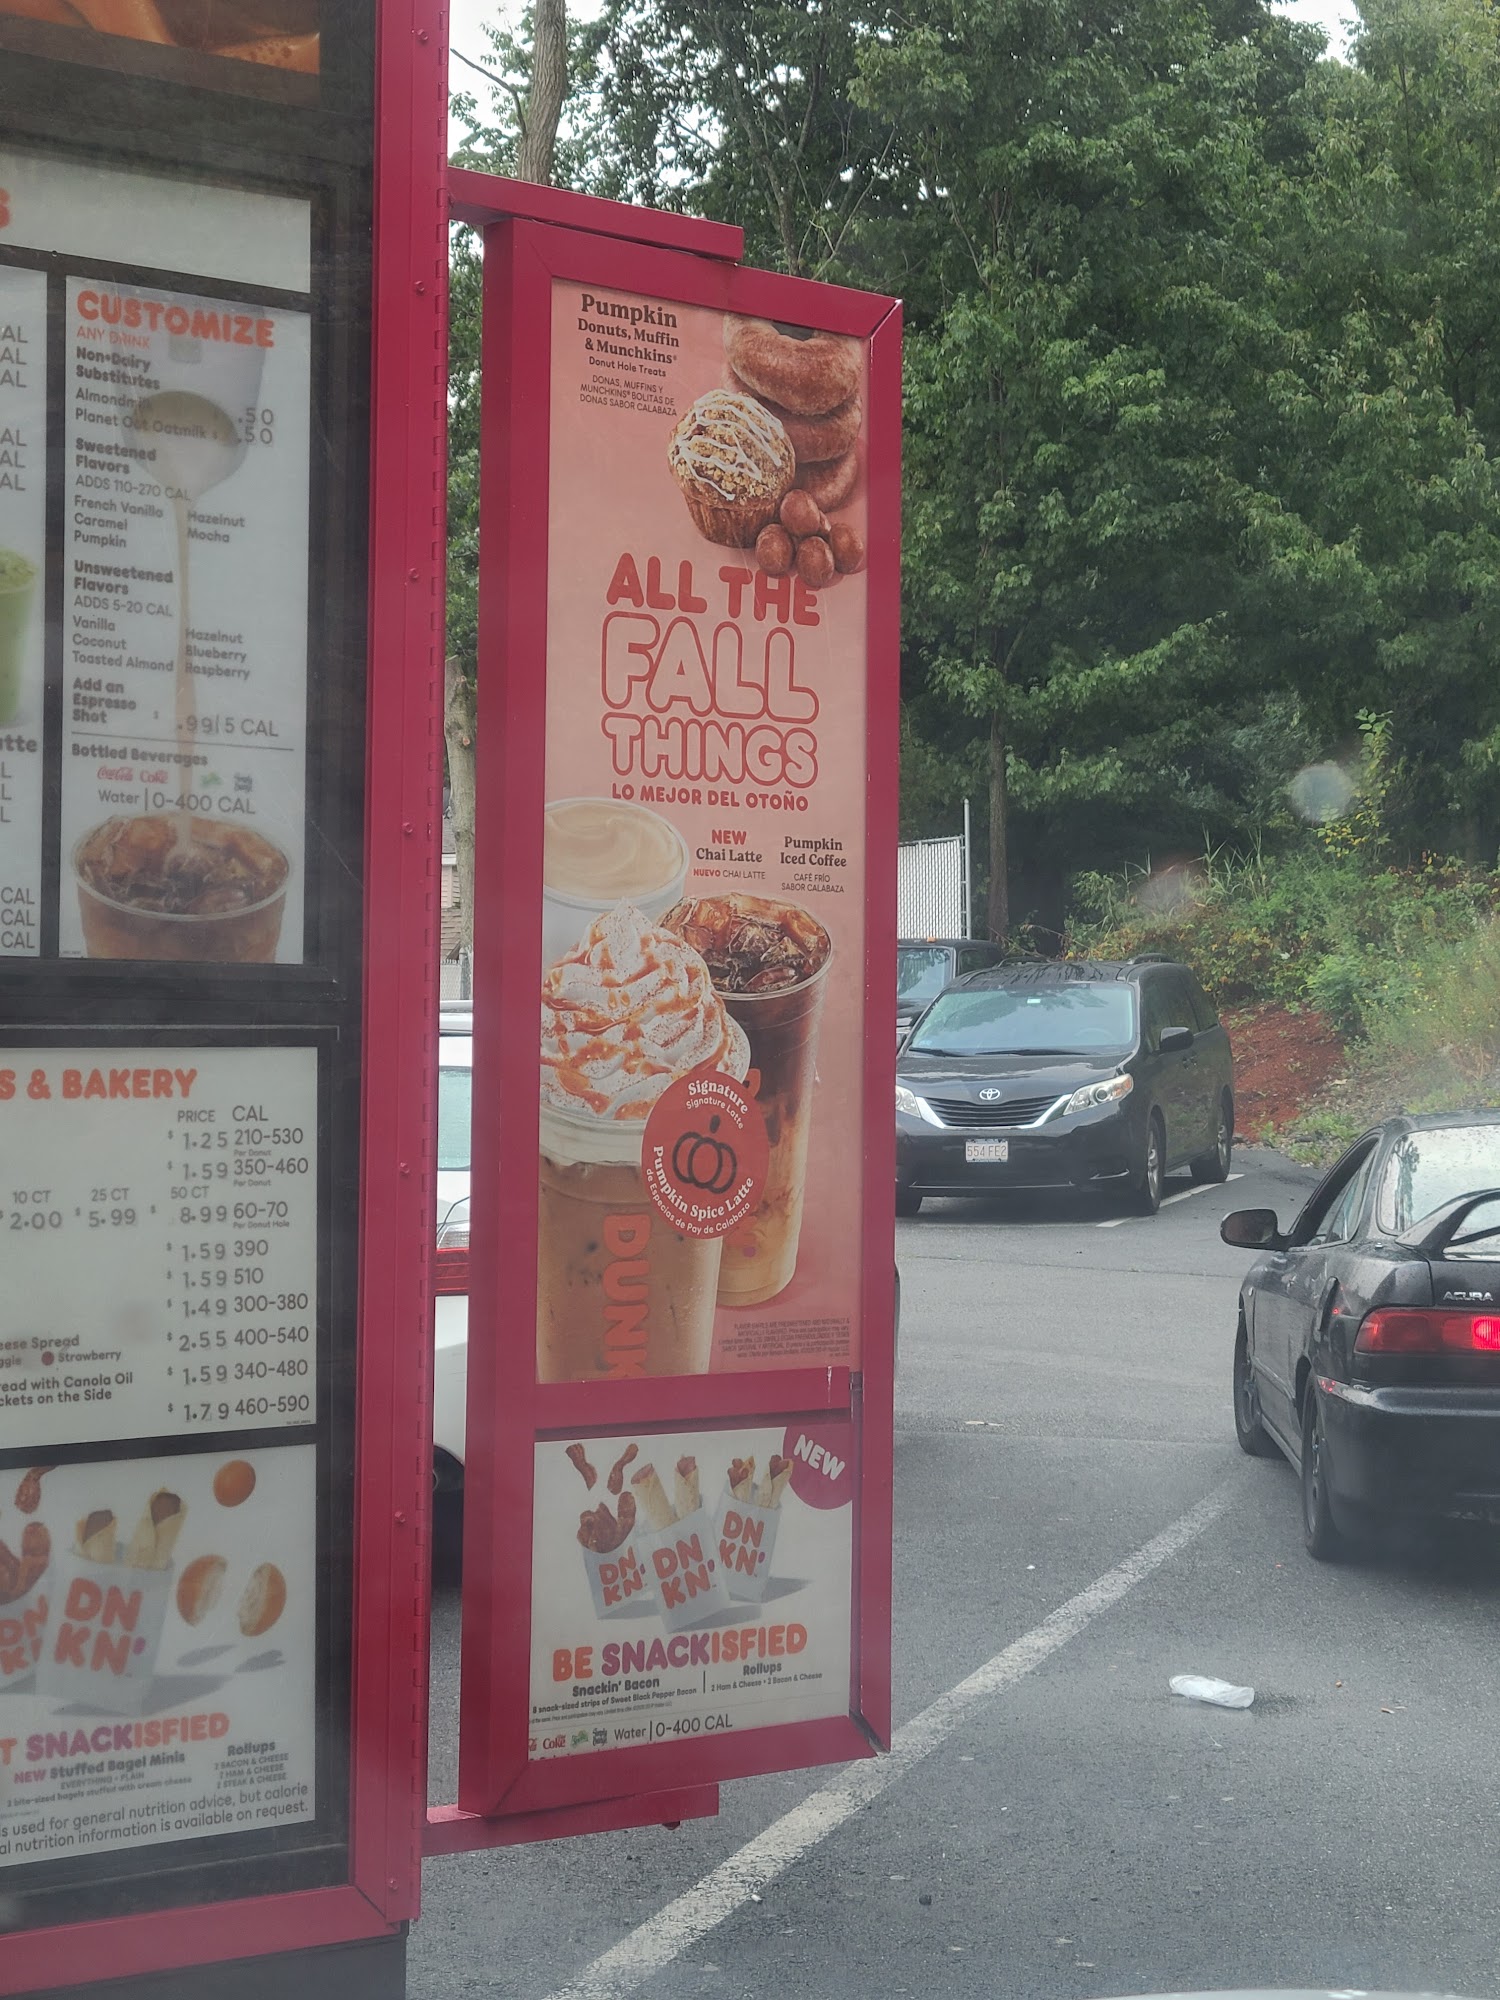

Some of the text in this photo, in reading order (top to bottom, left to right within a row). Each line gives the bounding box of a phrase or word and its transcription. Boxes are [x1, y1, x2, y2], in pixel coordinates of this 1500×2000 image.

[77, 290, 275, 348] CUSTOMIZE
[581, 294, 678, 328] Pumpkin
[77, 326, 150, 349] ANY DRINK
[578, 318, 679, 347] Donuts, Muffin
[585, 338, 594, 351] &
[589, 356, 666, 377] Donut Hole Treats
[76, 365, 160, 390] Substitutes
[76, 437, 157, 462] Sweetened
[76, 454, 130, 475] Flavors
[74, 495, 164, 518] French Vanilla
[74, 513, 128, 531] Caramel
[187, 510, 245, 528] Hazelnut
[74, 530, 128, 548] Pumpkin
[187, 528, 230, 544] Mocha
[74, 559, 174, 583] Unsweetened
[74, 576, 129, 595] Flavors
[606, 552, 820, 627] ALL THE
[74, 595, 173, 617] ADDS 5-20 CAL
[72, 615, 116, 631] Vanilla
[72, 633, 127, 650] Coconut
[185, 627, 244, 644] Hazelnut
[72, 650, 174, 672] Toasted Almond
[185, 644, 247, 663] Blueberry
[185, 661, 250, 682] Raspberry
[601, 610, 820, 724] FALL
[73, 676, 125, 694] Add an
[73, 692, 137, 711] Espresso
[72, 708, 107, 724] Shot
[72, 743, 208, 767] Bottled Beverages
[601, 712, 818, 788] THINGS
[98, 788, 255, 814] Water 0-400 CAL
[612, 783, 808, 811] LO MEJOR DEL OTOÑO
[712, 829, 746, 845] NEW
[784, 836, 843, 852] Pumpkin
[696, 848, 762, 863] Chai Latte
[780, 852, 847, 867] Iced Coffee
[693, 868, 765, 879] NUEVO CHAI LATTE
[794, 873, 812, 882] CAFÉ
[782, 883, 844, 893] SABOR CALABAZA
[62, 1068, 198, 1099] BAKERY
[688, 1080, 748, 1115] Signature
[177, 1105, 269, 1123] PRICE CAL
[686, 1097, 743, 1129] Signature Latte
[233, 1128, 303, 1146] 210-530
[233, 1157, 308, 1176] 350-460
[170, 1185, 210, 1200] 50 CT
[654, 1145, 754, 1222] Pumpkin Spice Latte
[13, 1190, 51, 1204] 10 CT
[91, 1188, 130, 1202] 25 CT
[233, 1200, 288, 1219] 60-70
[650, 1183, 675, 1221] Especias
[676, 1218, 685, 1229] de
[687, 1223, 702, 1236] Pay
[704, 1224, 714, 1234] de
[715, 1202, 750, 1232] Calabaza
[233, 1239, 269, 1256] 390
[234, 1267, 264, 1285] 510
[234, 1293, 308, 1313] 300-380
[1443, 1291, 1494, 1301] ACURA
[31, 1333, 80, 1351] Spread
[234, 1326, 309, 1347] 400-540
[58, 1349, 121, 1363] Strawberry
[234, 1359, 308, 1380] 340-480
[30, 1371, 133, 1391] with Canola Oil
[37, 1388, 112, 1405] on the Side
[234, 1394, 310, 1415] 460-590
[793, 1433, 846, 1481] NEW
[552, 1623, 808, 1682] BE SNACKISFIED
[743, 1662, 782, 1677] Rollups
[572, 1677, 660, 1698] Snackin' Bacon
[538, 1700, 579, 1714] snack-sized
[581, 1699, 601, 1709] strips
[602, 1697, 609, 1705] of
[611, 1695, 631, 1704] Sweet
[633, 1692, 651, 1703] Black
[652, 1690, 675, 1701] Pepper
[676, 1688, 697, 1697] Bacon
[26, 1712, 230, 1762] SNACKISFIED
[614, 1727, 646, 1741] Water
[655, 1718, 700, 1737] 0-400
[705, 1714, 733, 1730] CAL
[227, 1741, 276, 1757] Rollups
[14, 1750, 185, 1784] NEW Stuffed Bagel Minis
[13, 1782, 308, 1836] used for general nutrition advice, but calorie
[15, 1801, 308, 1853] nutrition information is available on request.
